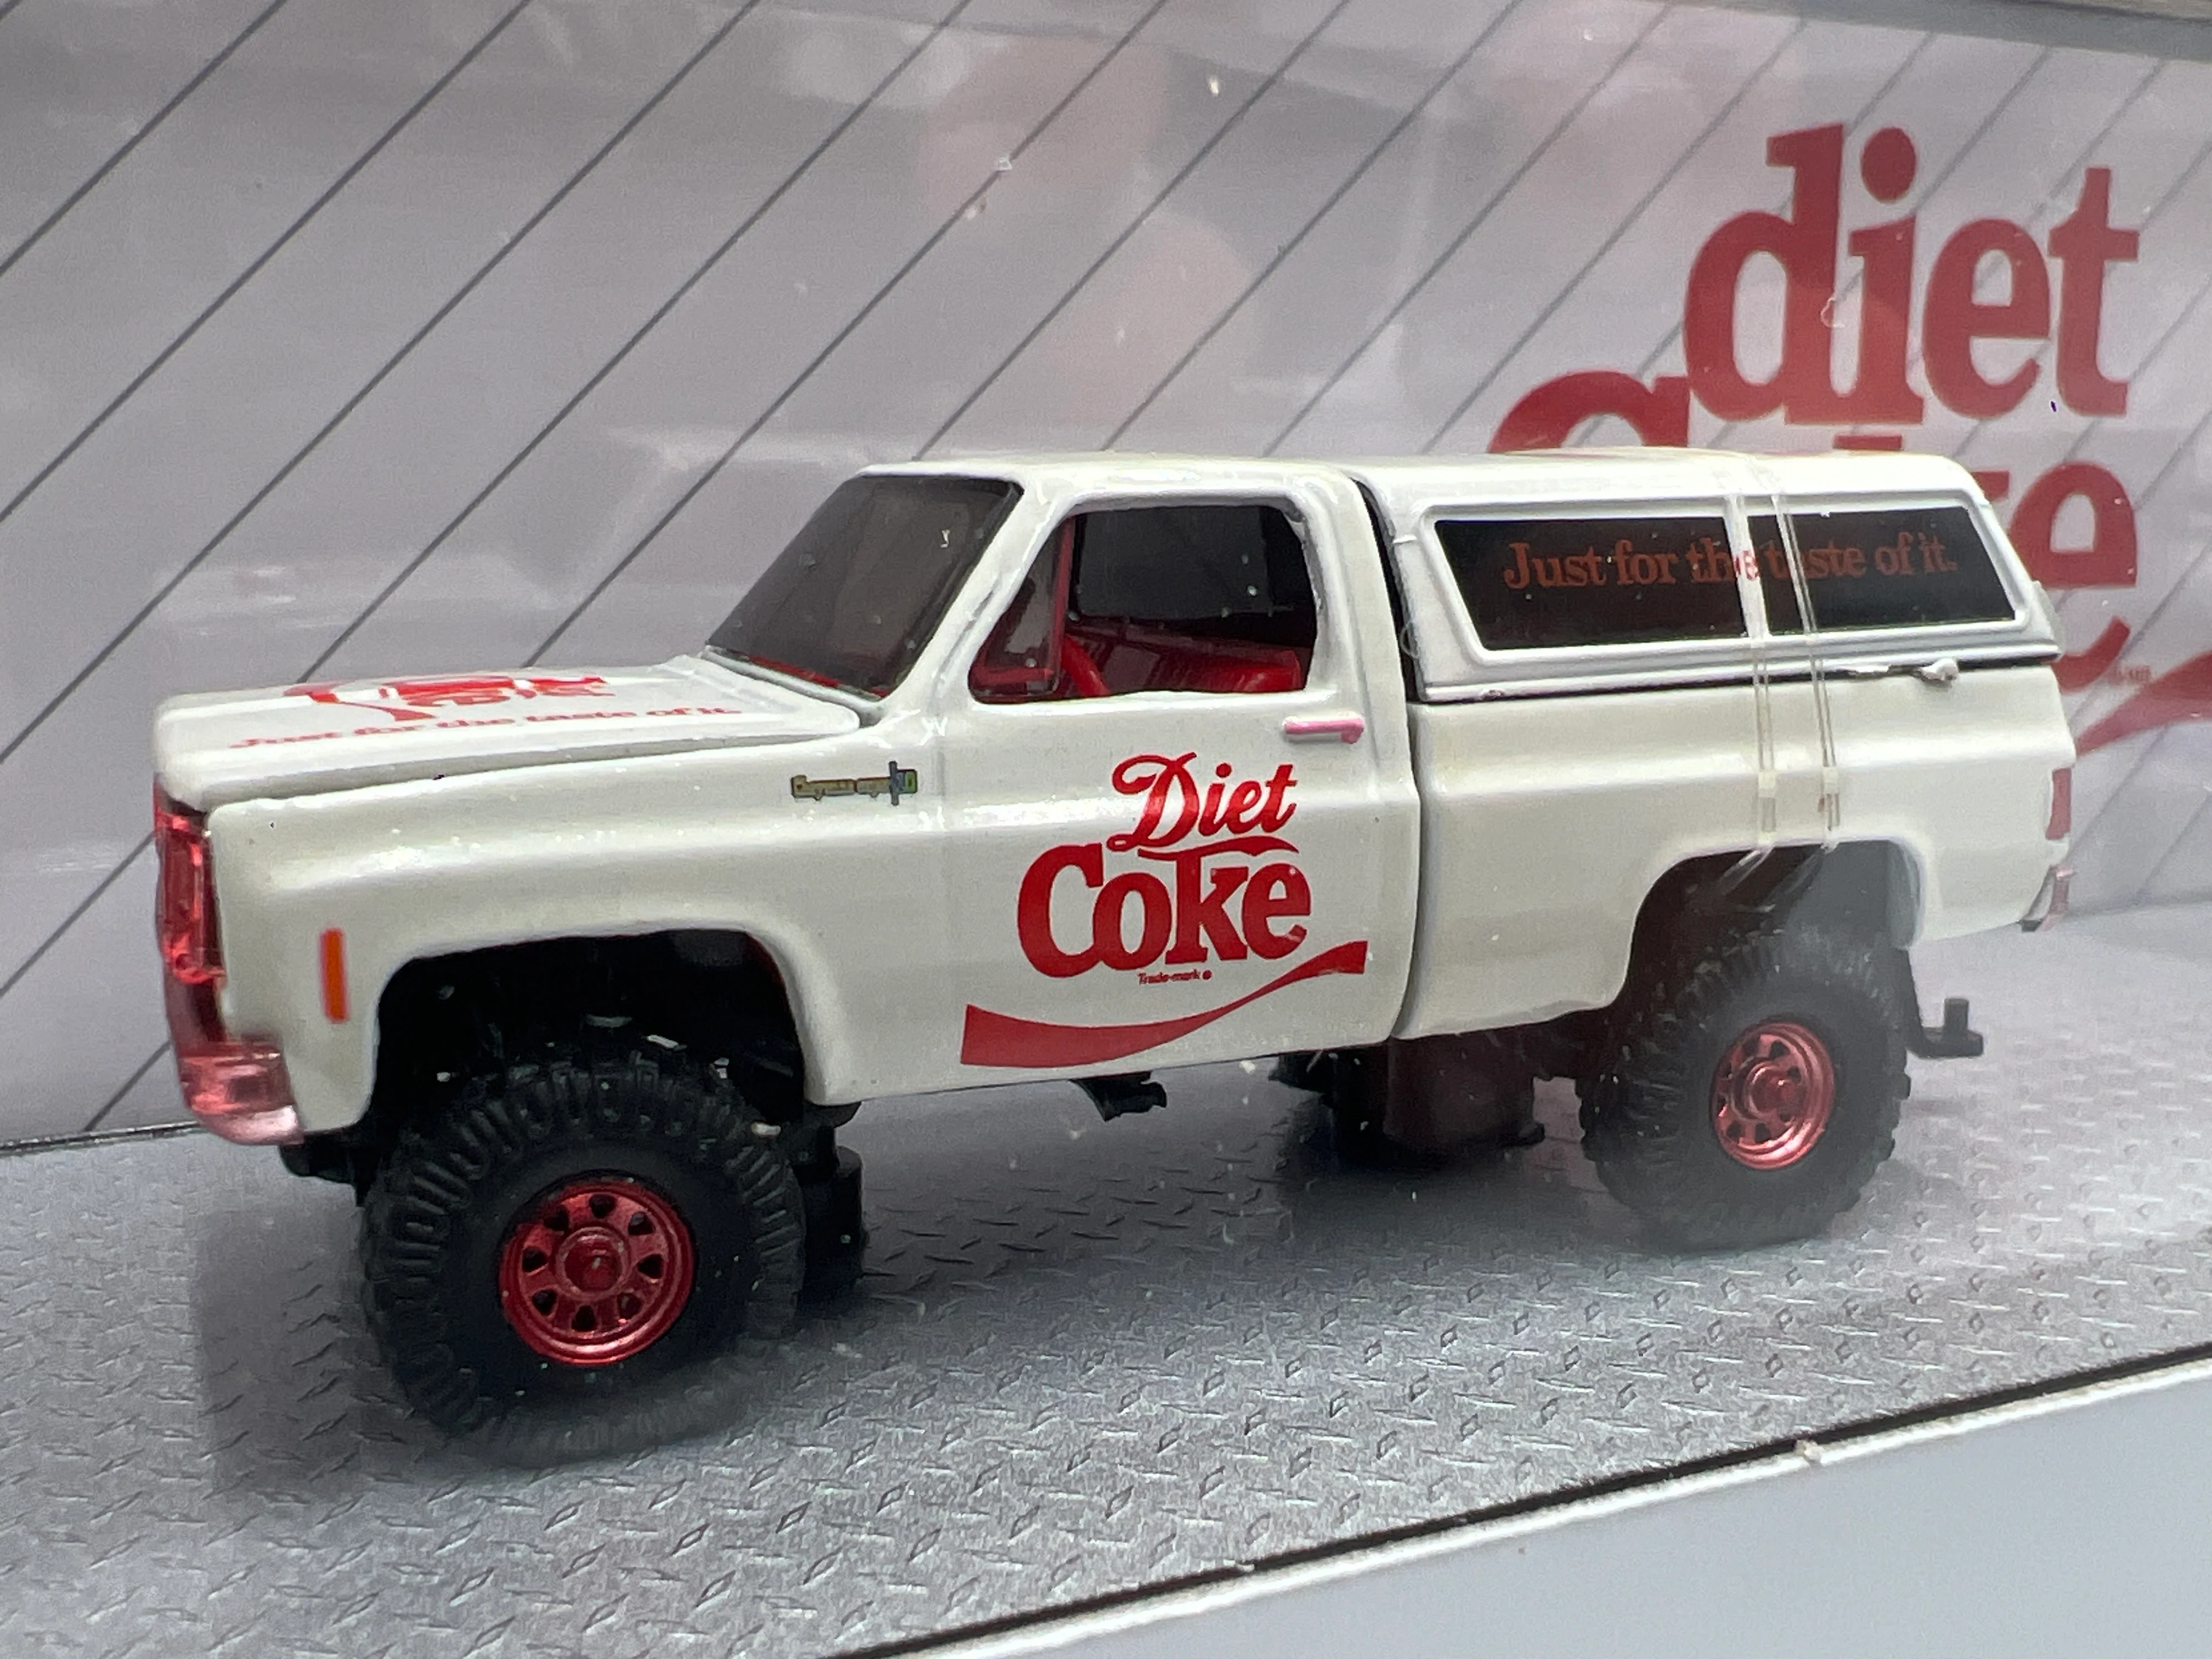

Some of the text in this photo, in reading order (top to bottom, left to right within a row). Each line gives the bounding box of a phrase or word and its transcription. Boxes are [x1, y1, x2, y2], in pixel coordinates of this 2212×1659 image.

[1683, 123, 2138, 425] diet
[1503, 541, 1607, 590] Just
[1613, 538, 1678, 585] for
[1874, 531, 1914, 575] of
[1107, 752, 1297, 852] Diet
[1017, 836, 1311, 979] Coke
